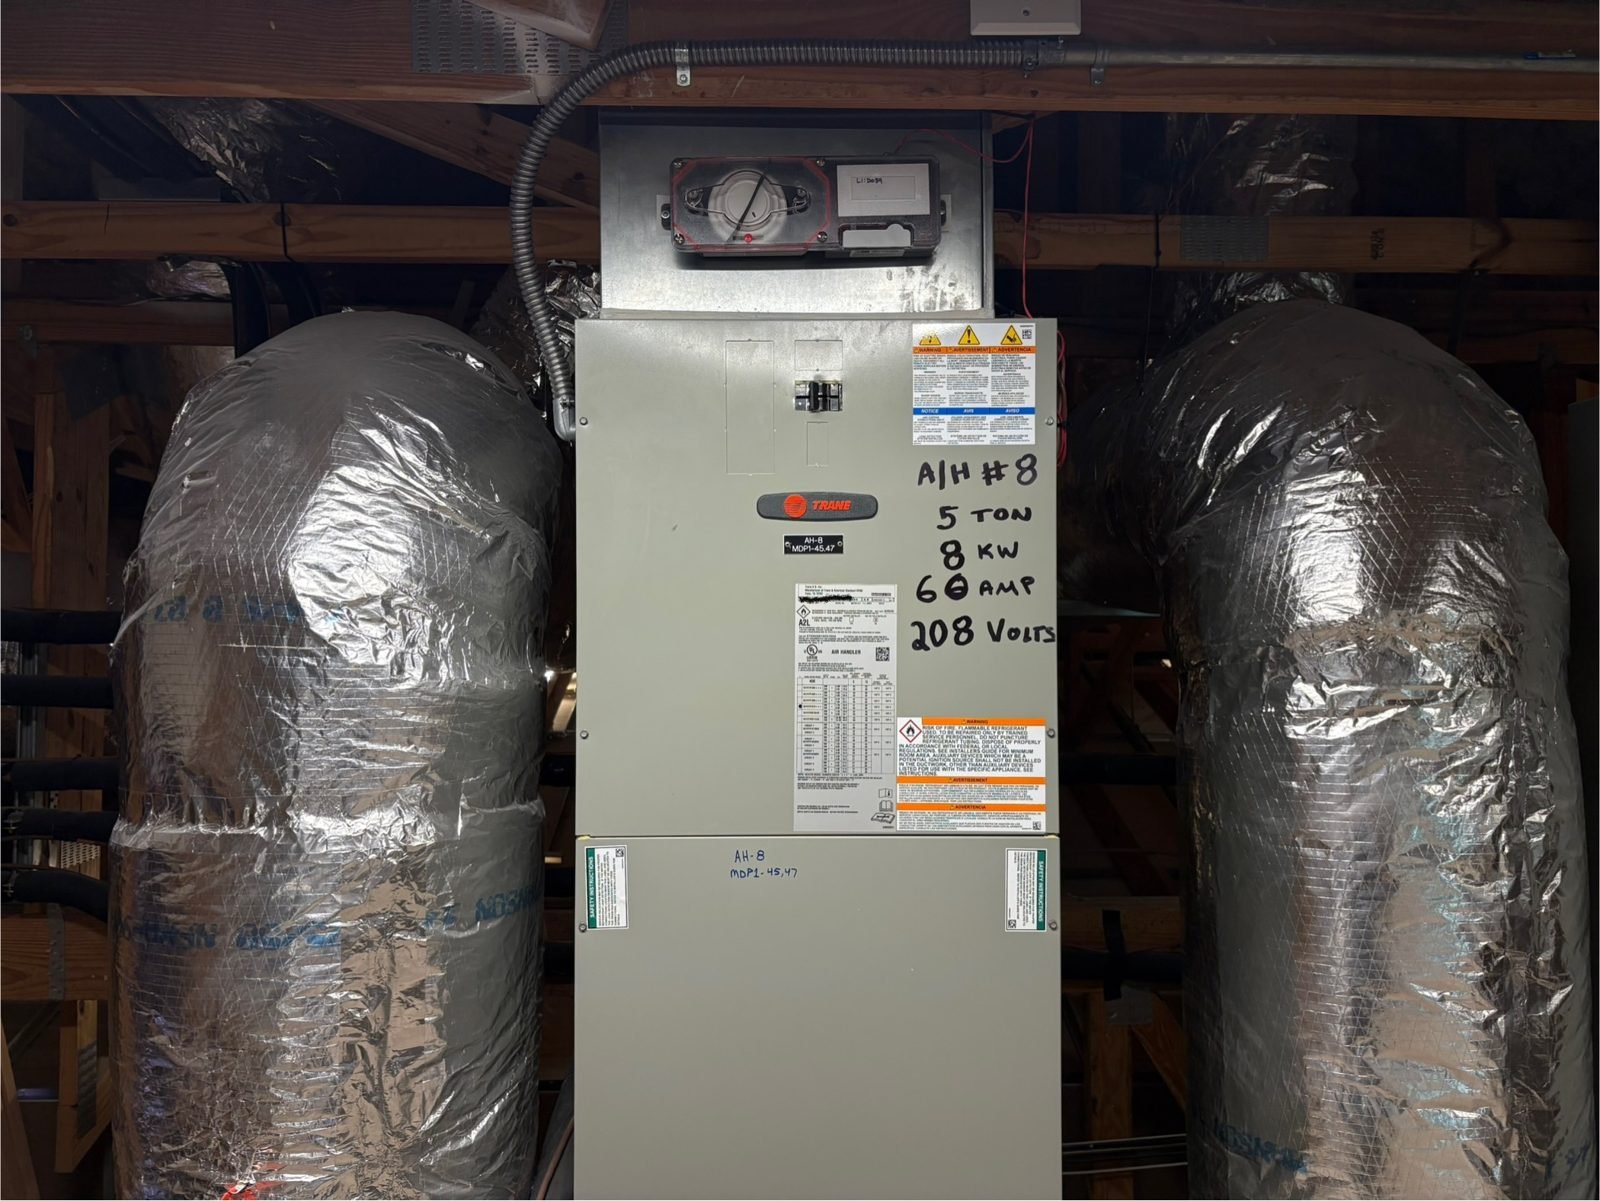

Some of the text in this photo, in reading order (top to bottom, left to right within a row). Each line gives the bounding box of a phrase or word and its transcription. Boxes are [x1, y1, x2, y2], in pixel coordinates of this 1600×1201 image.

[812, 500, 852, 511] TRANE
[936, 505, 1032, 530] 5 TON
[940, 539, 1019, 571] 8 KW
[916, 572, 1035, 603] 60 AMP
[910, 615, 974, 651] 208
[734, 849, 765, 863] AH-8
